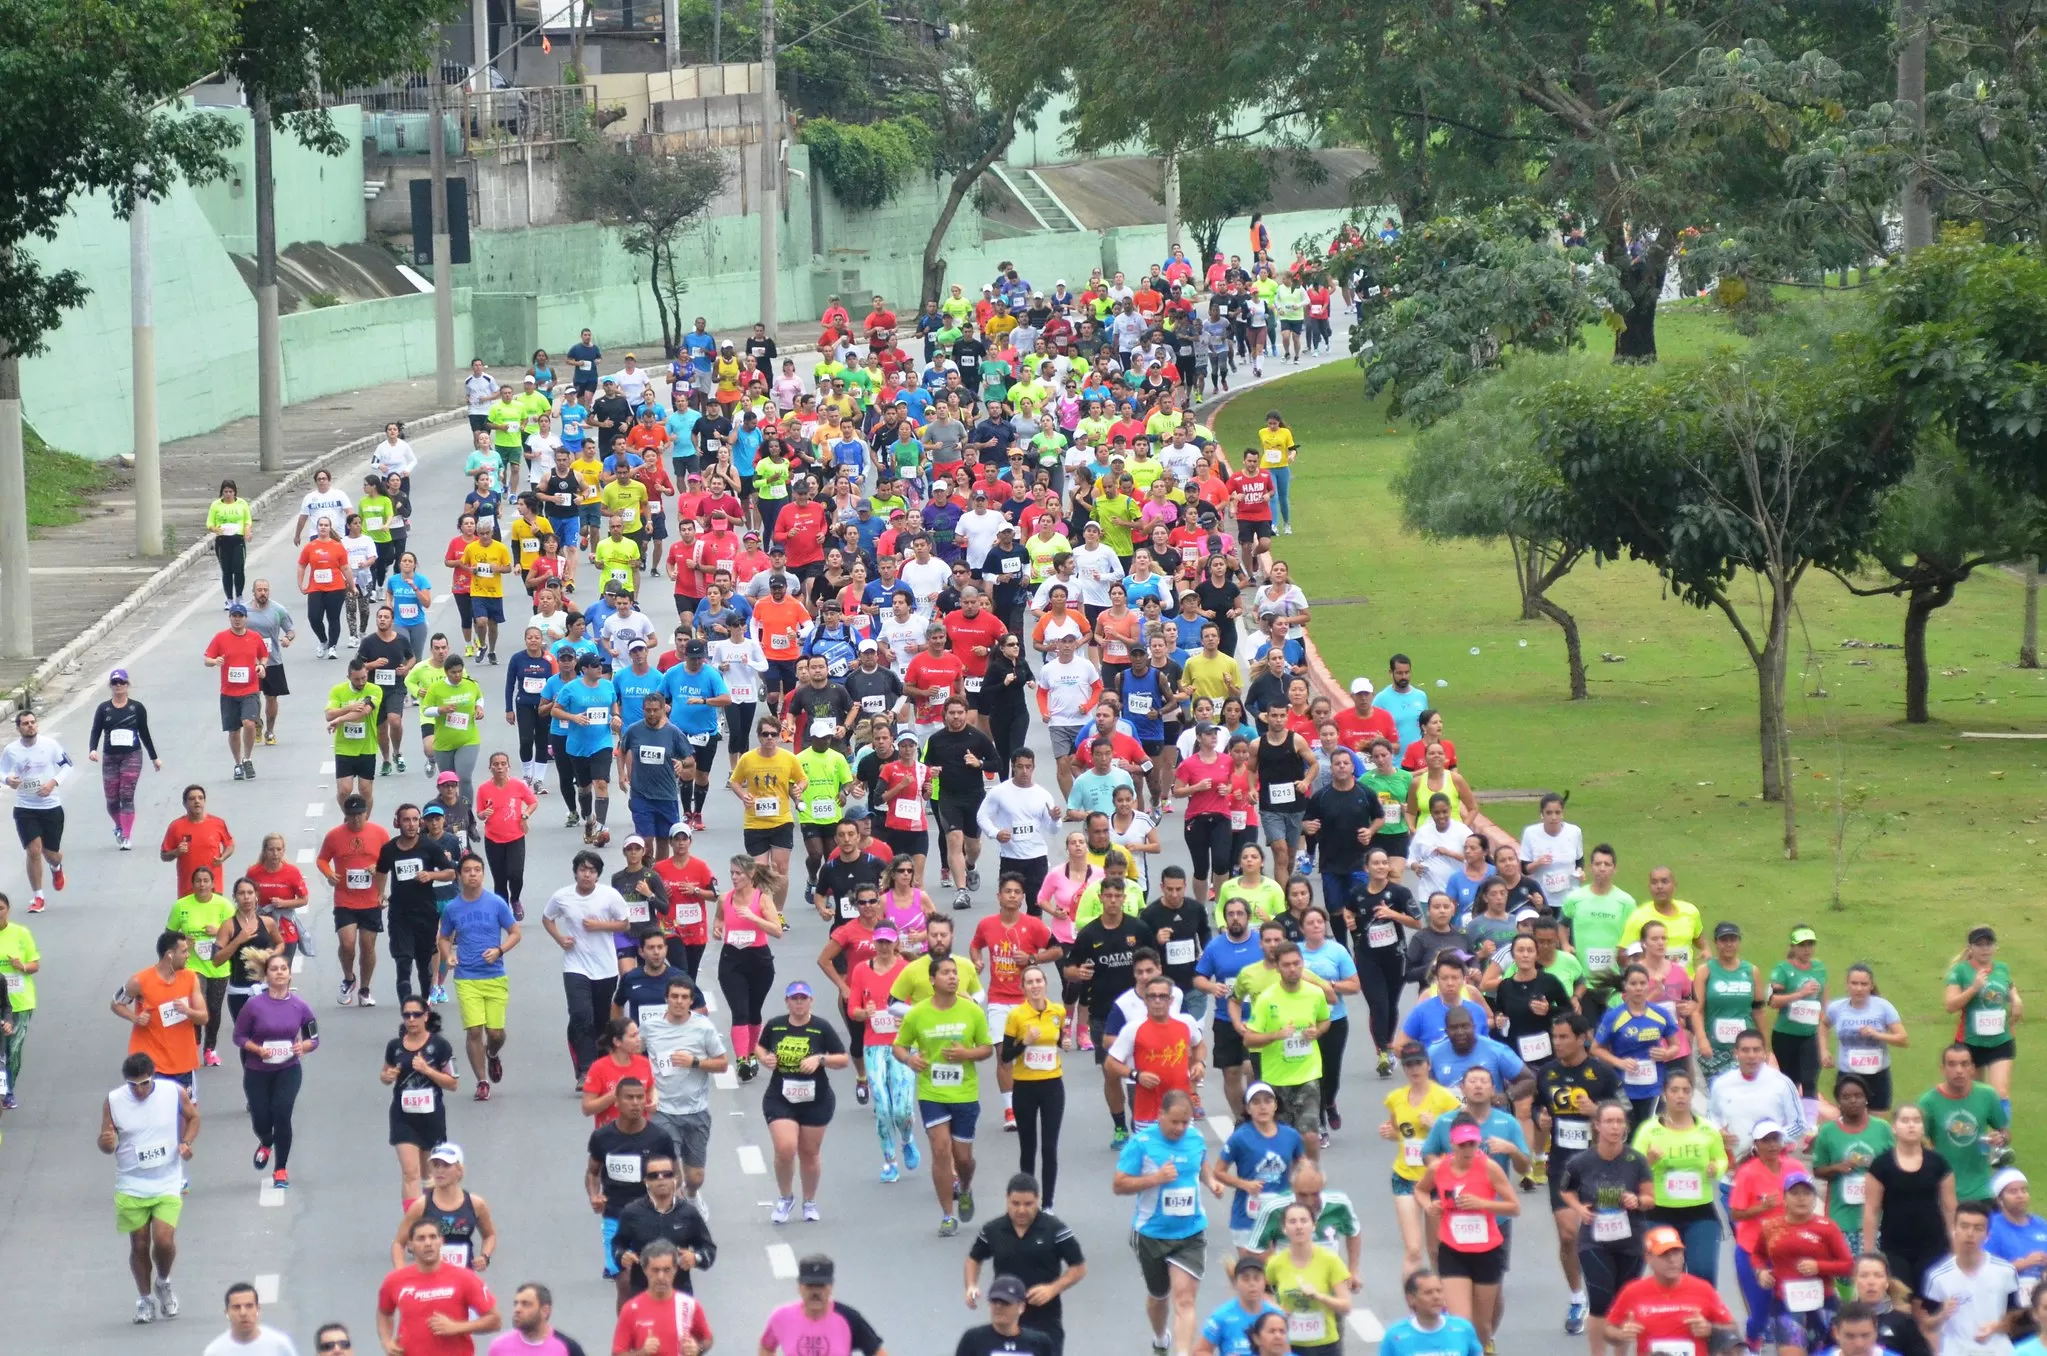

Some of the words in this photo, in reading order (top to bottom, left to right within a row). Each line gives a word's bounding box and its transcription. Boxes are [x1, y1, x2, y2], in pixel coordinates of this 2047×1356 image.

[1242, 483, 1264, 493] HARD
[1243, 492, 1264, 502] KICK
[1003, 561, 1019, 569] 6144
[229, 671, 246, 679] 6251
[375, 673, 392, 681] 6128
[1129, 700, 1148, 709] 6164
[22, 780, 41, 789] 6192
[1271, 789, 1292, 798] 6213
[813, 805, 832, 813] 5656
[349, 874, 367, 883] 249
[1099, 952, 1133, 965] QATAR
[1589, 954, 1612, 964] 5922
[874, 1017, 892, 1026] 503
[1841, 1018, 1880, 1028] EQUIPE
[935, 1070, 956, 1080] 612
[1669, 1144, 1701, 1159] LIFE
[609, 1163, 634, 1175] 5959
